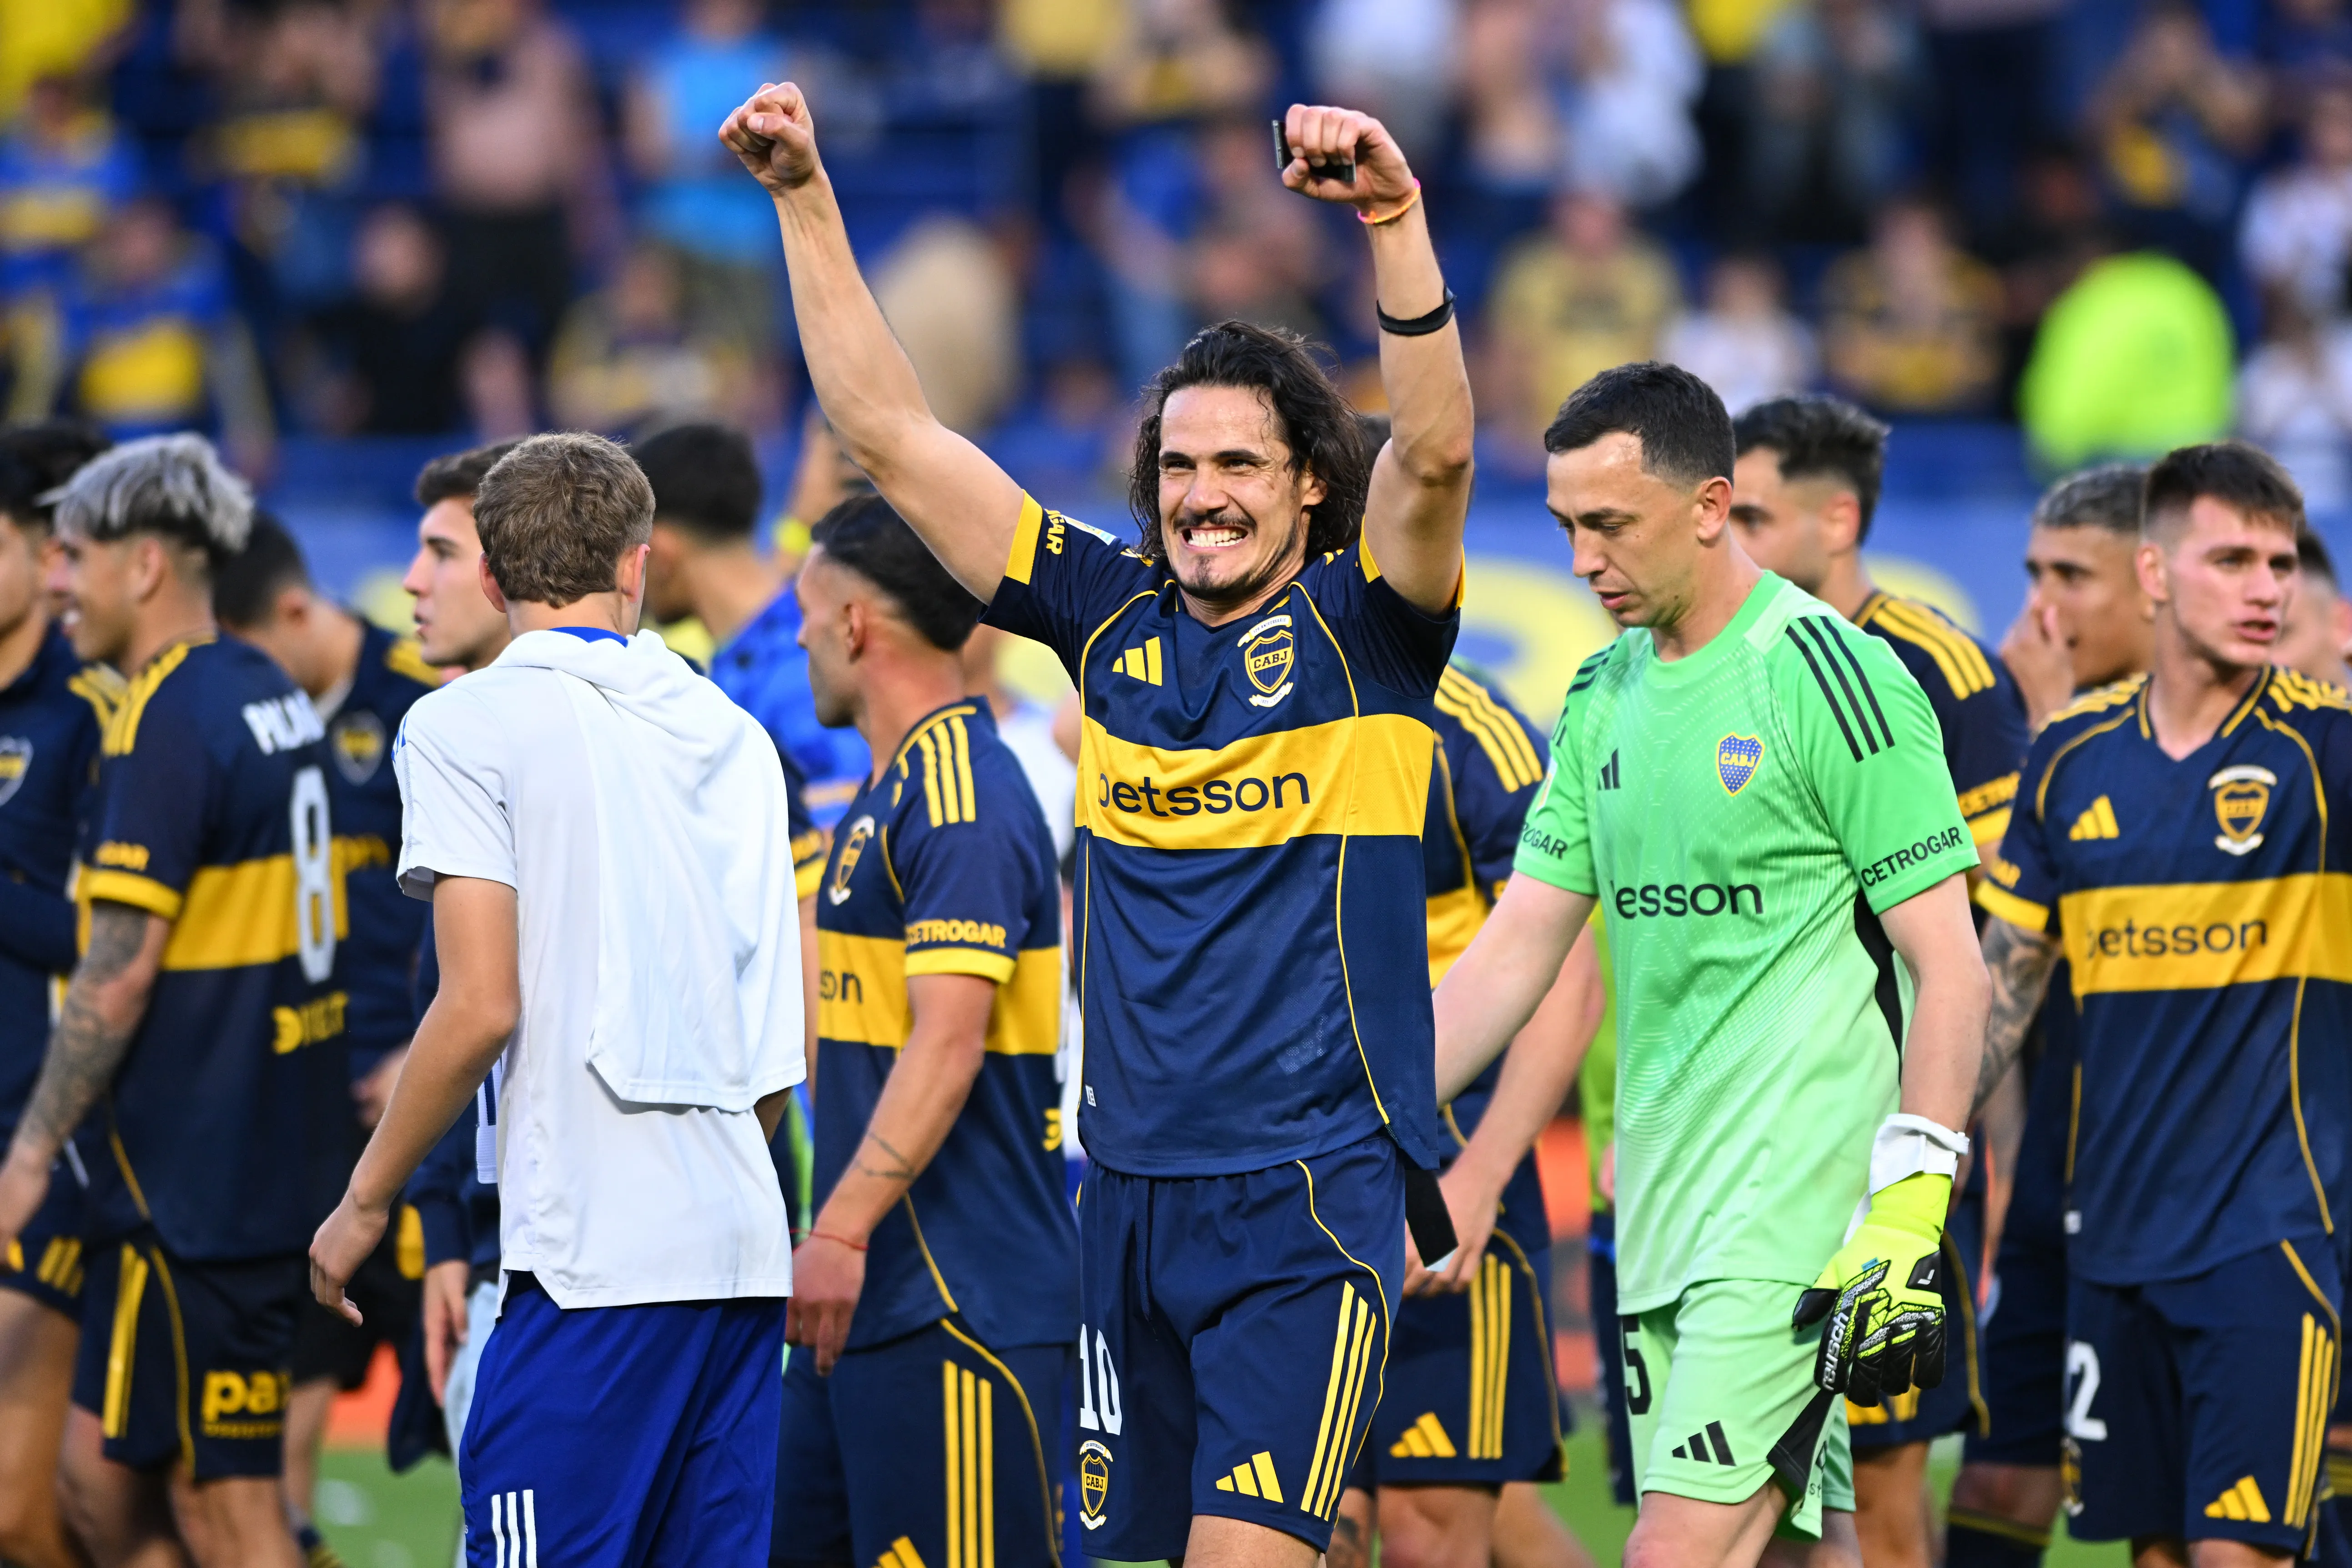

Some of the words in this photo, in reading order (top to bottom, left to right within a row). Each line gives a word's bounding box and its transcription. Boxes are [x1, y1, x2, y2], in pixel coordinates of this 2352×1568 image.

[1254, 651, 1287, 669] CABJ
[1720, 752, 1757, 768] CABJ
[290, 765, 337, 985] 8
[1861, 826, 1963, 887] CETROGAR
[1080, 1323, 1122, 1436] 10
[1822, 1312, 1849, 1392] reusch
[1086, 1476, 1104, 1489] CABJ
